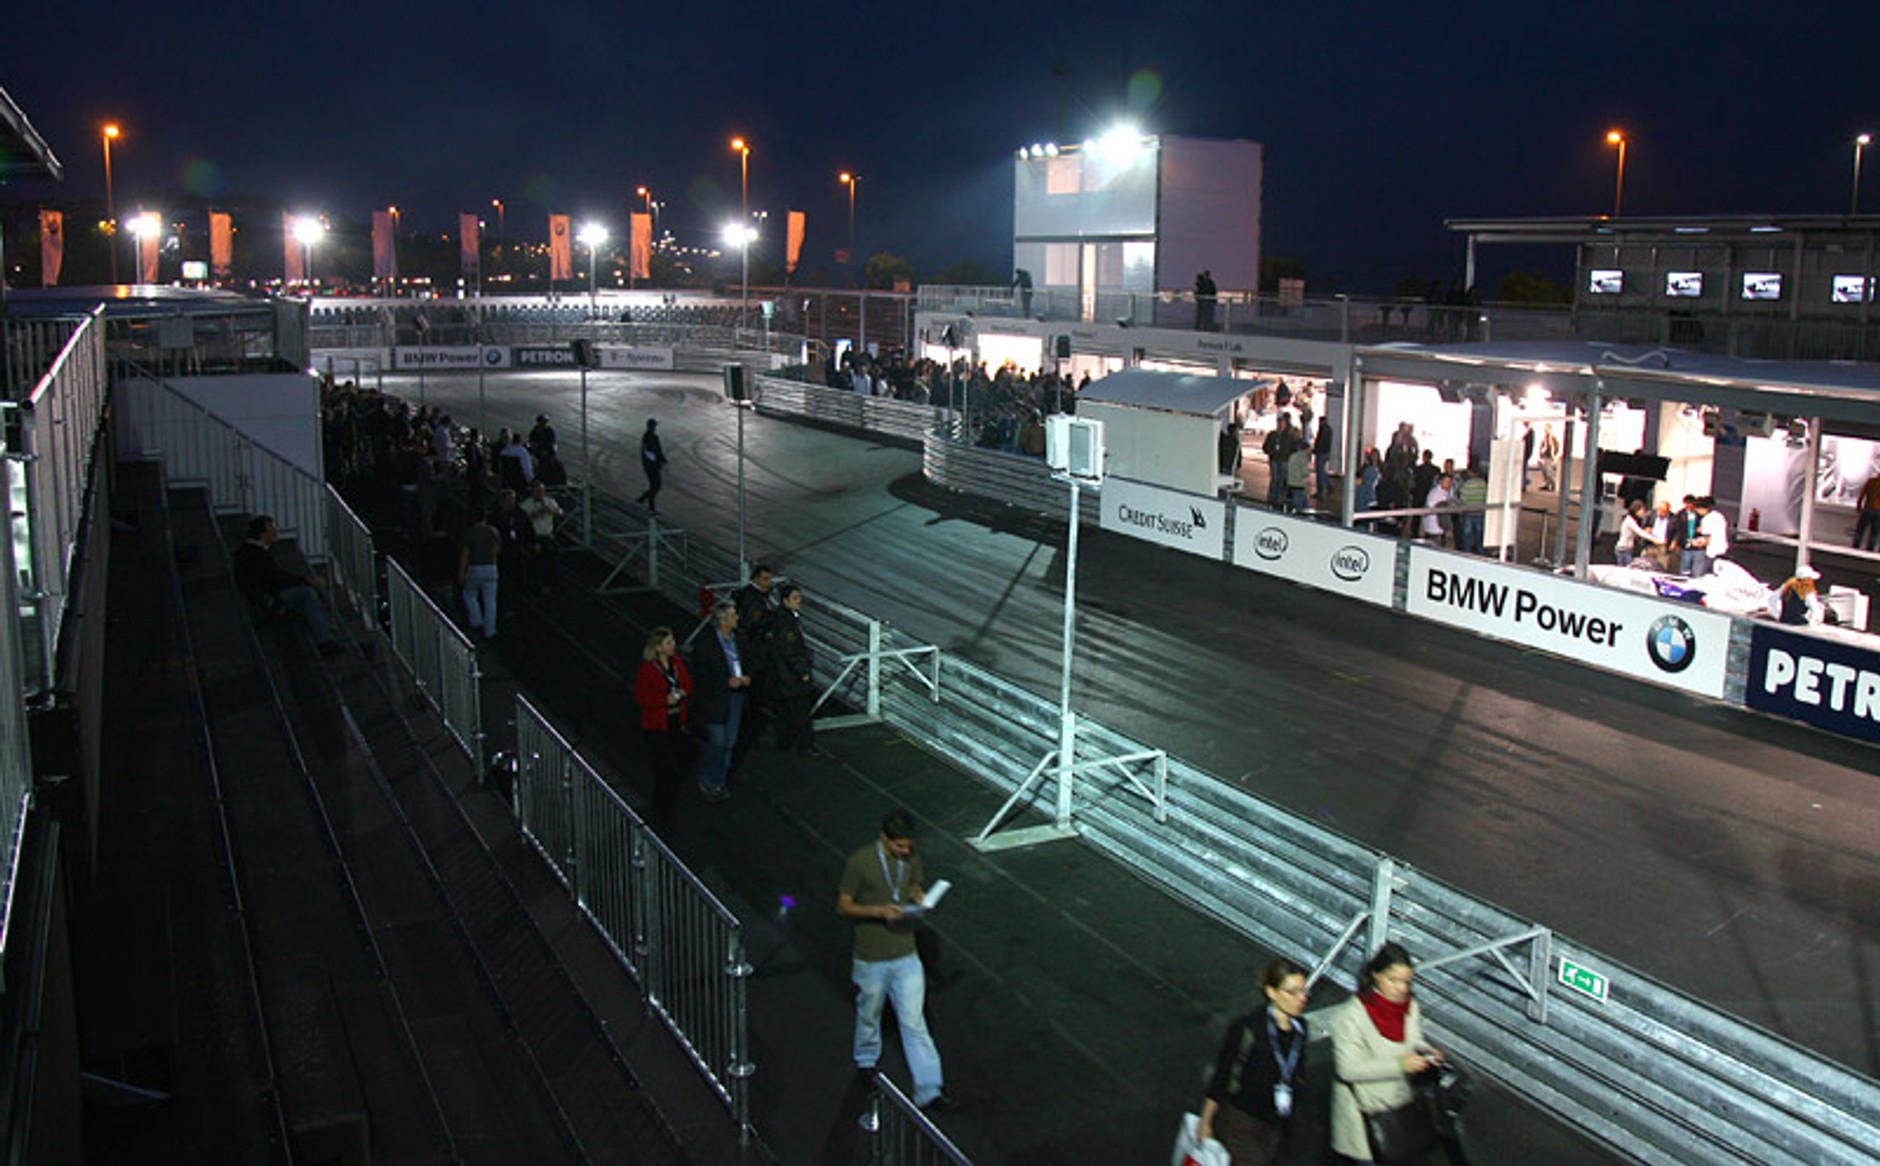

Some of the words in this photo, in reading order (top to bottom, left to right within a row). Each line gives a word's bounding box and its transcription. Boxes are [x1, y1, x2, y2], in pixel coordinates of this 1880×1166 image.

[403, 352, 439, 364] BMW
[440, 351, 478, 364] Power
[1118, 503, 1157, 529] CREDIT
[1158, 514, 1194, 540] SUISSE
[1259, 534, 1283, 553] intel
[1336, 554, 1363, 573] intel
[1426, 568, 1510, 618] BMW
[1514, 589, 1624, 648] Power
